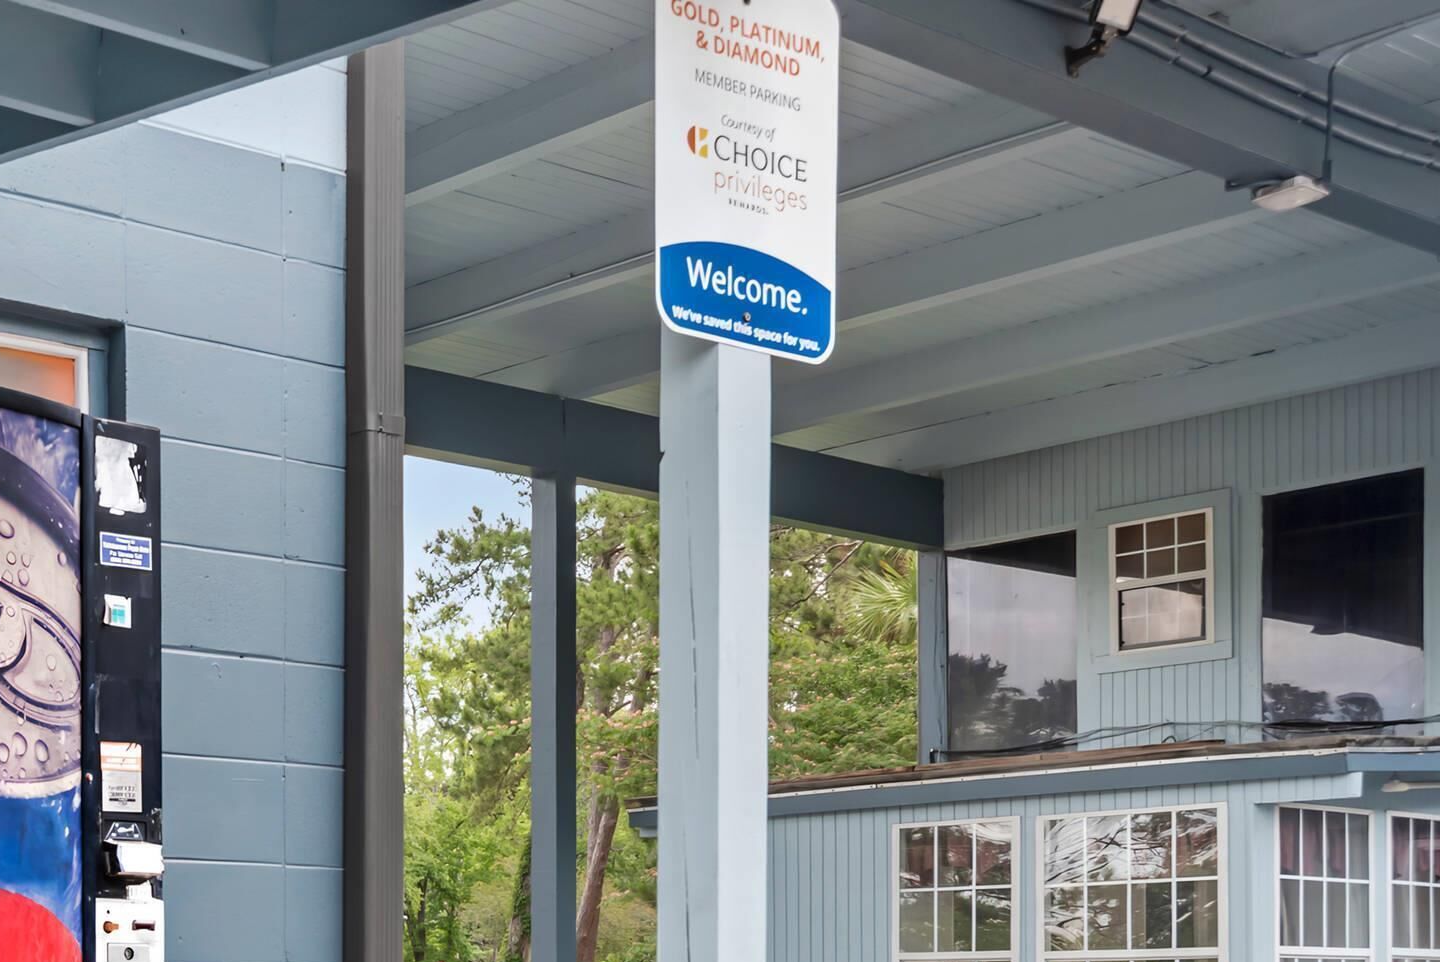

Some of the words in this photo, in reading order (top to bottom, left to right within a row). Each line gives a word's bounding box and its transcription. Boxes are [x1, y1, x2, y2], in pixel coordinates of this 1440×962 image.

[671, 0, 724, 33] GOLD,
[730, 15, 824, 64] PLATINUM,
[696, 30, 708, 51] &
[714, 35, 800, 76] DIAMOND
[694, 68, 747, 96] MEMBER
[750, 84, 801, 112] PARKING
[720, 114, 763, 139] Courtesy
[765, 127, 776, 143] of
[714, 135, 808, 182] CHOICE
[714, 170, 808, 212] privileges
[686, 256, 808, 315] Welcome.
[671, 304, 702, 324] We've
[703, 314, 732, 331] saved
[733, 320, 753, 336] this
[753, 327, 782, 343] space
[783, 331, 799, 347] for
[799, 337, 821, 352] you.
